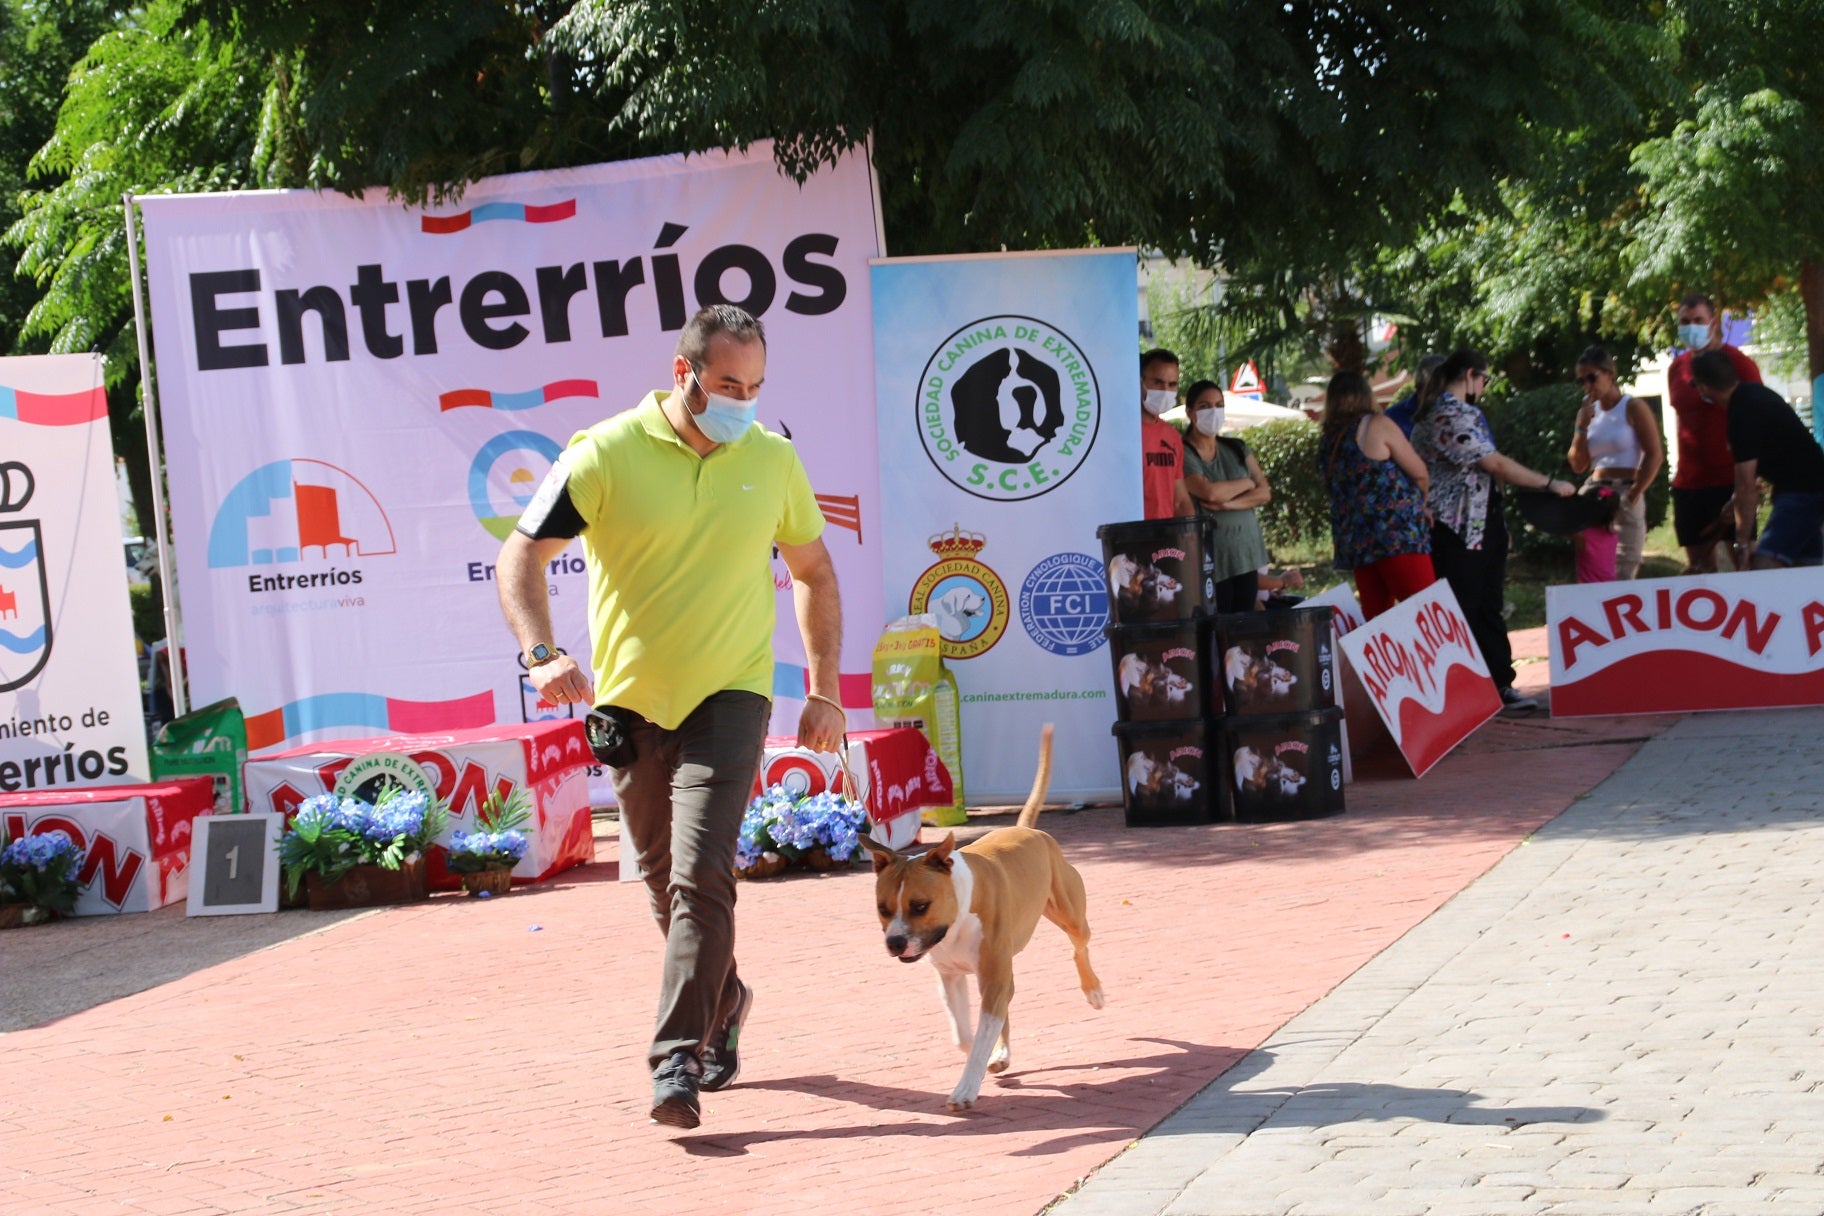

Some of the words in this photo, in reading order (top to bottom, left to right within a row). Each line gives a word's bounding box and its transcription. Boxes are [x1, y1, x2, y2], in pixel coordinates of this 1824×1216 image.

[189, 221, 847, 371] Entrerríos
[937, 325, 1008, 372] CANINA
[1014, 325, 1040, 343] DE
[1042, 336, 1092, 457] EXTREMADURA
[925, 376, 960, 462] SOCIEDAD
[966, 461, 1060, 491] S.C.E.
[1145, 452, 1175, 467] PUMA
[248, 567, 363, 593] Entrerríos
[467, 553, 586, 582] Enrío
[1025, 554, 1097, 588] CYNOLOGIQUE
[923, 562, 980, 588] SOCIEDAD
[982, 572, 1005, 617] CANINA
[1049, 594, 1091, 615] FCI
[1021, 591, 1056, 651] FEDERATION
[1558, 588, 1782, 671] ARION
[942, 638, 989, 655] SPAÑA
[1363, 632, 1426, 725] ARION
[1414, 601, 1476, 694] ARION
[82, 707, 110, 728] de
[0, 742, 129, 791] erríos
[343, 758, 381, 784] CANINA
[384, 758, 399, 769] DE
[225, 845, 240, 879] 1
